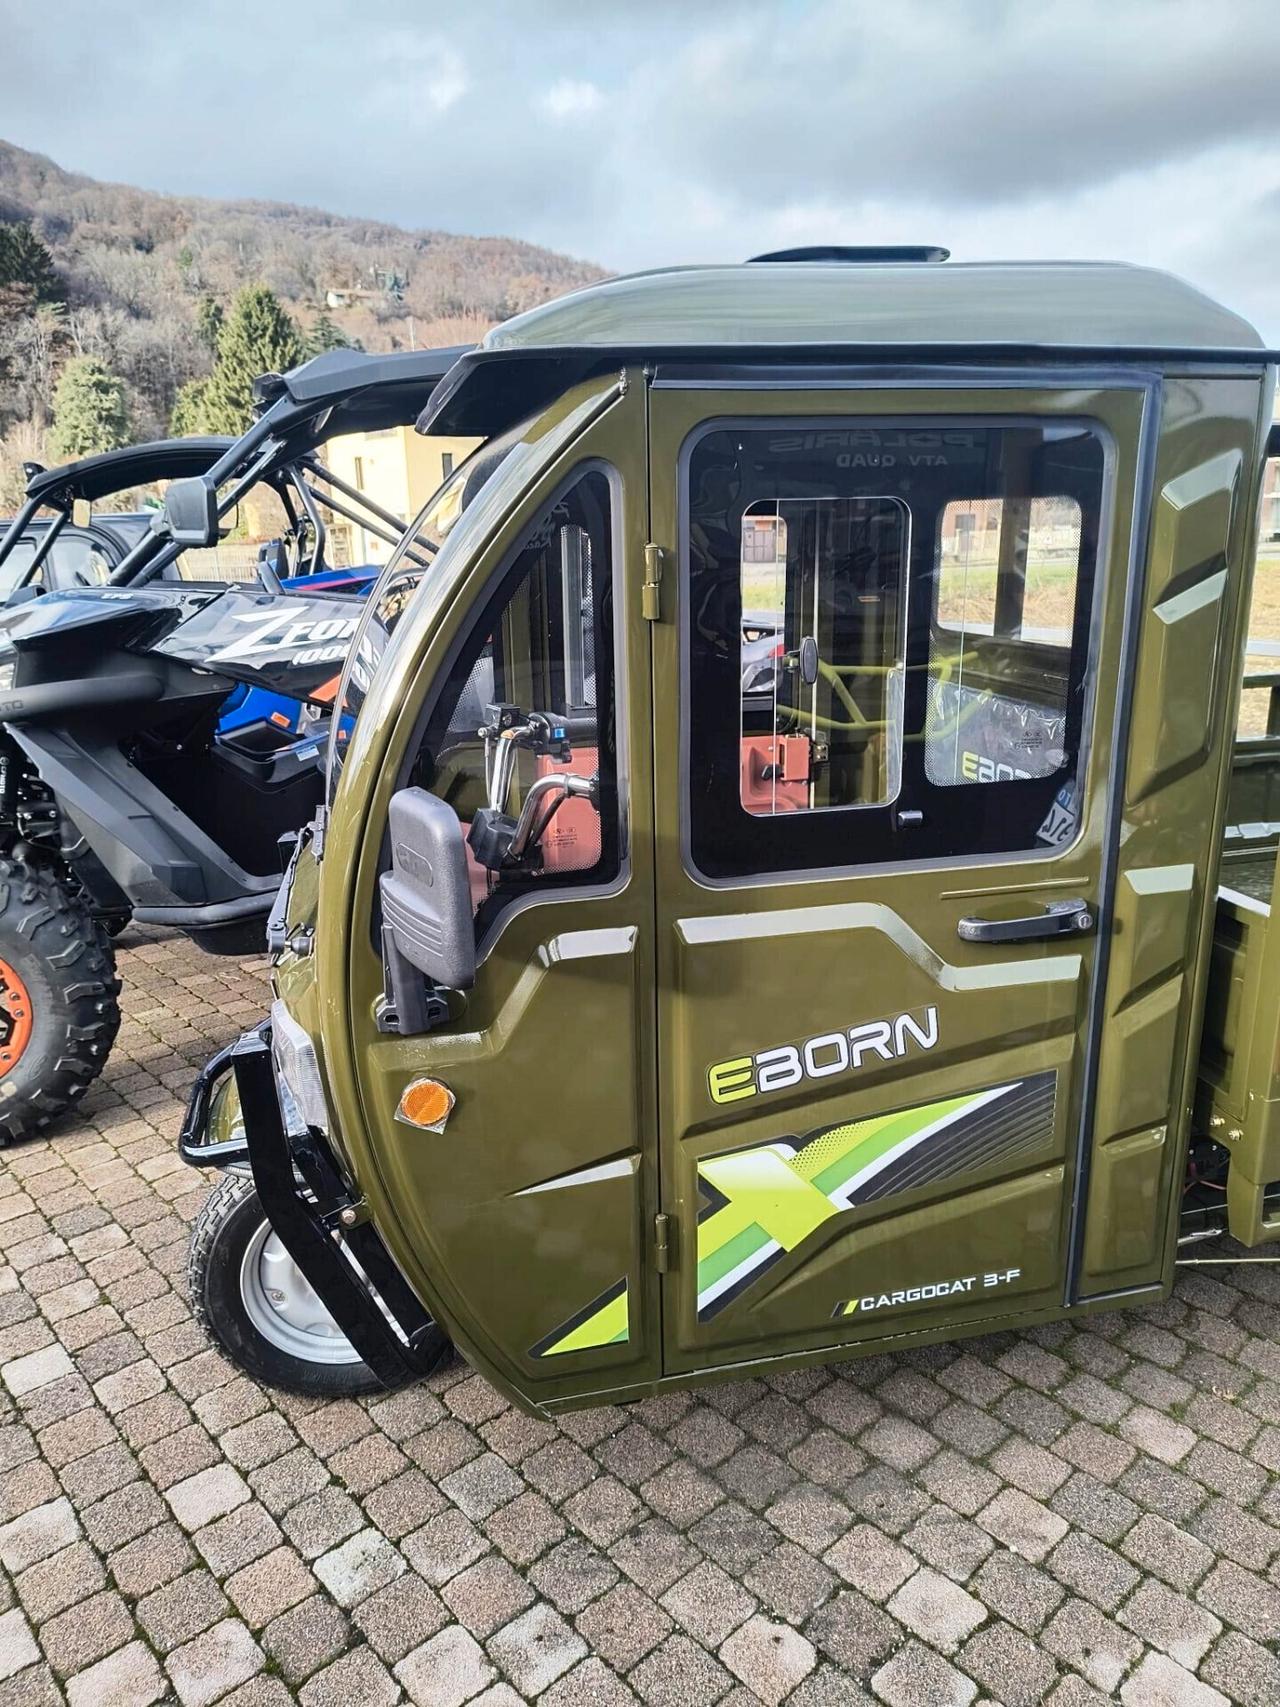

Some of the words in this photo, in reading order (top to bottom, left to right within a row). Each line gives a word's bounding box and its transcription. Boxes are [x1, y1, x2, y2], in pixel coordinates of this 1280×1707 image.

[708, 1005, 939, 1105] EBORN
[860, 1277, 976, 1311] CARGOCAT
[983, 1268, 1021, 1287] 3-F
